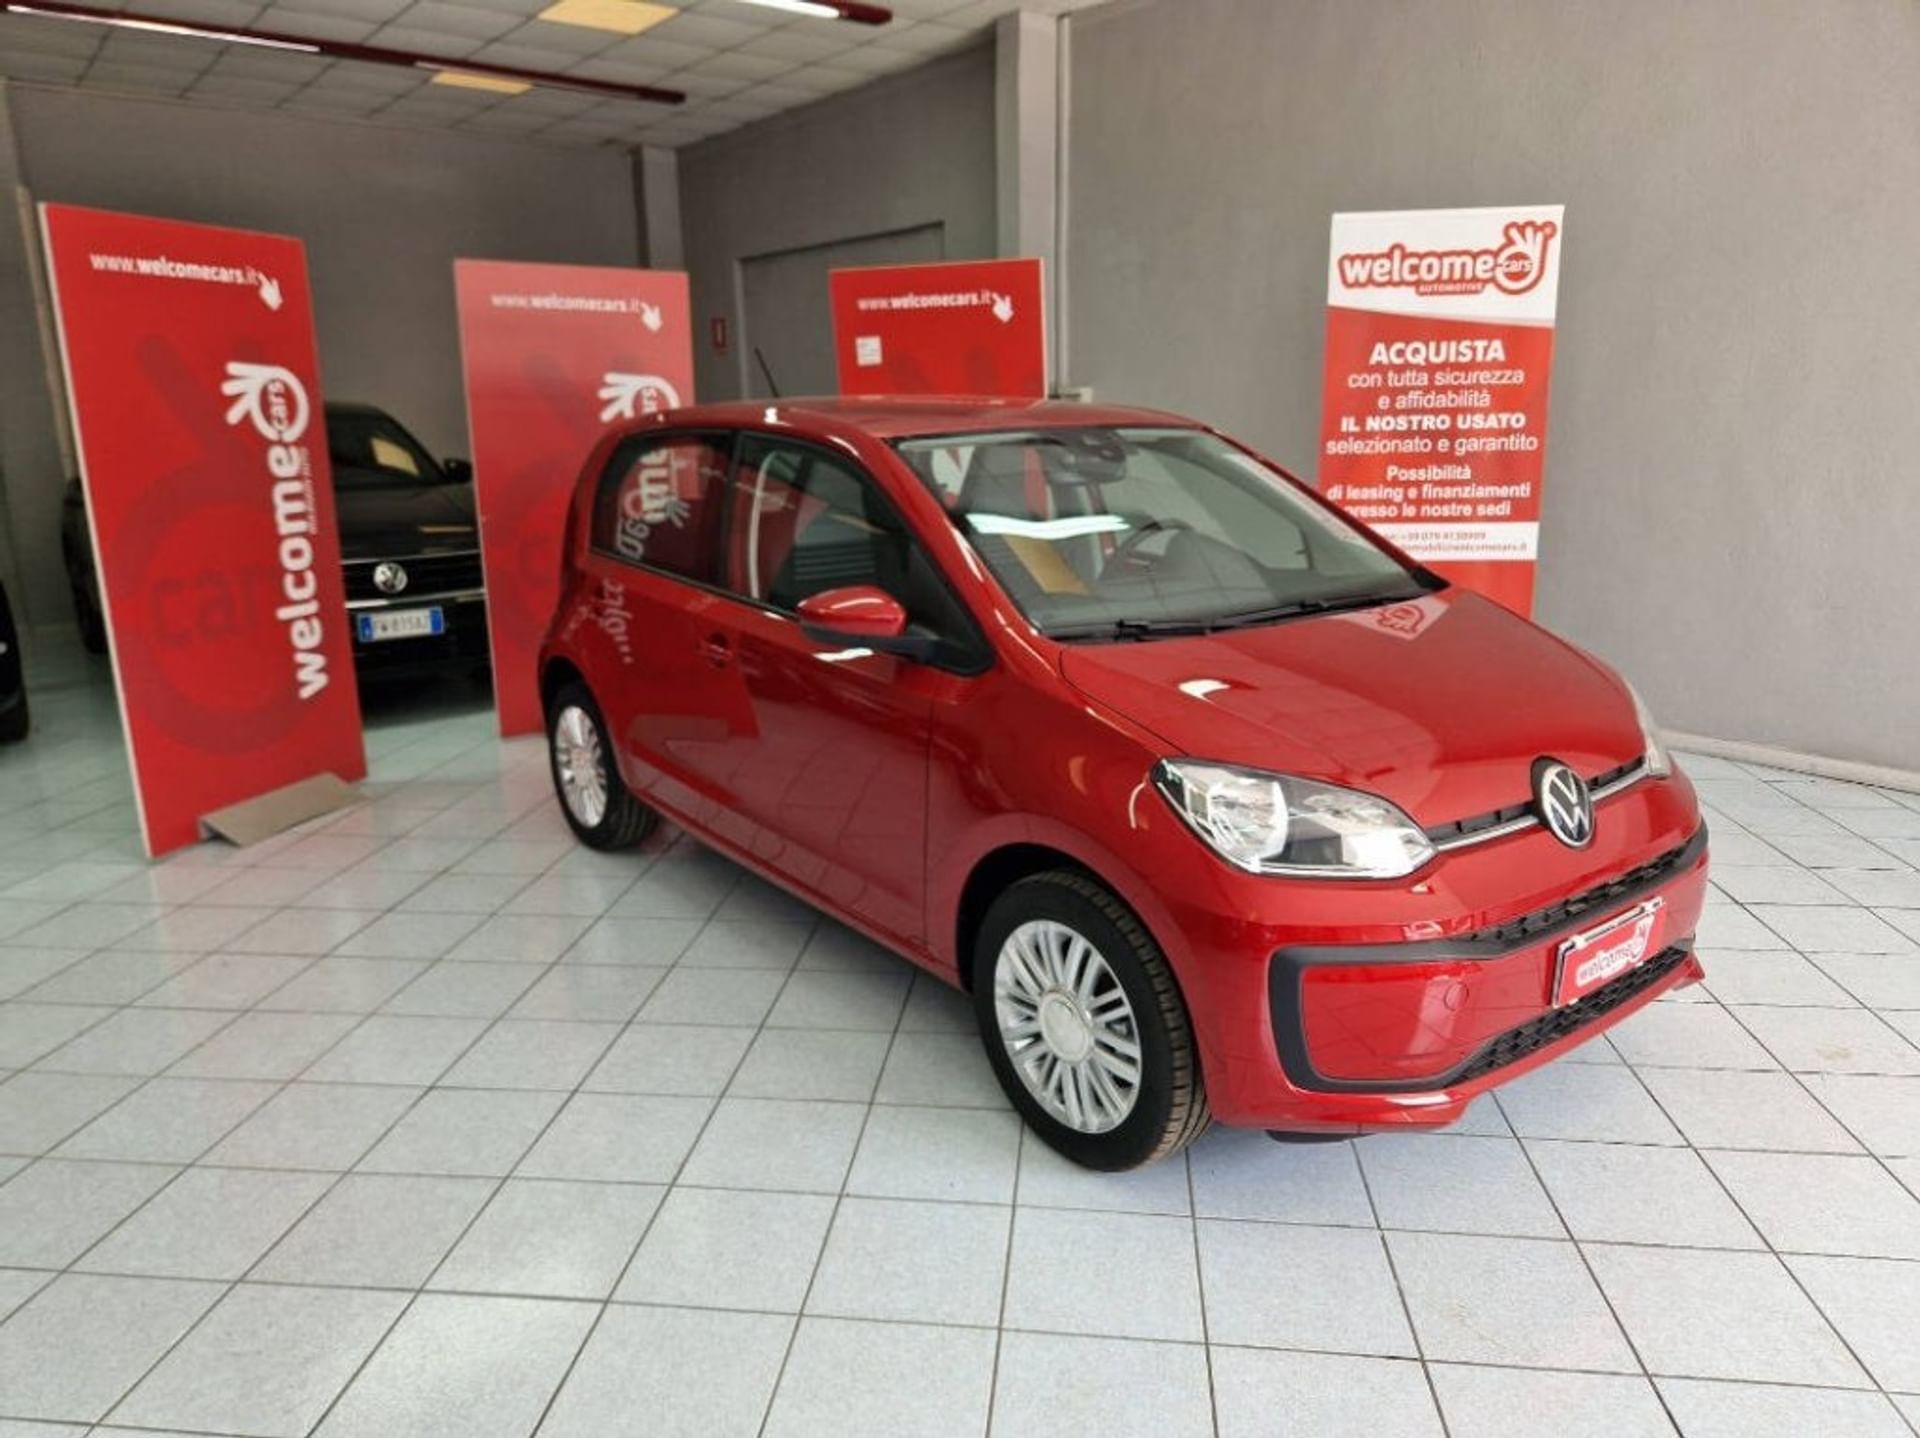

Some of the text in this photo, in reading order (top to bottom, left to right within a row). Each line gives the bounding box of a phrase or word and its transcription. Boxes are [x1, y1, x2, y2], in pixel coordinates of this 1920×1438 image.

[89, 253, 258, 286] www.welcomecars.it
[1340, 248, 1533, 286] welcome cars
[490, 293, 641, 313] www.welcomecars.it
[856, 289, 992, 311] www.welcomecars.it
[1369, 339, 1505, 365] ACQUISTA
[1347, 367, 1525, 388] con tutta sicurezza
[267, 377, 289, 432] cars
[1378, 390, 1491, 410] e affidabilità
[1341, 413, 1527, 432] IL NOSTRO USATO
[1325, 433, 1538, 456] selezionato e garantito
[1386, 463, 1472, 482] Possibilità
[1327, 482, 1531, 502] di leasing e finanziamenti
[1401, 502, 1418, 518] le
[1420, 503, 1474, 518] nostre
[1477, 500, 1512, 516] sedi
[266, 445, 330, 700] welcome
